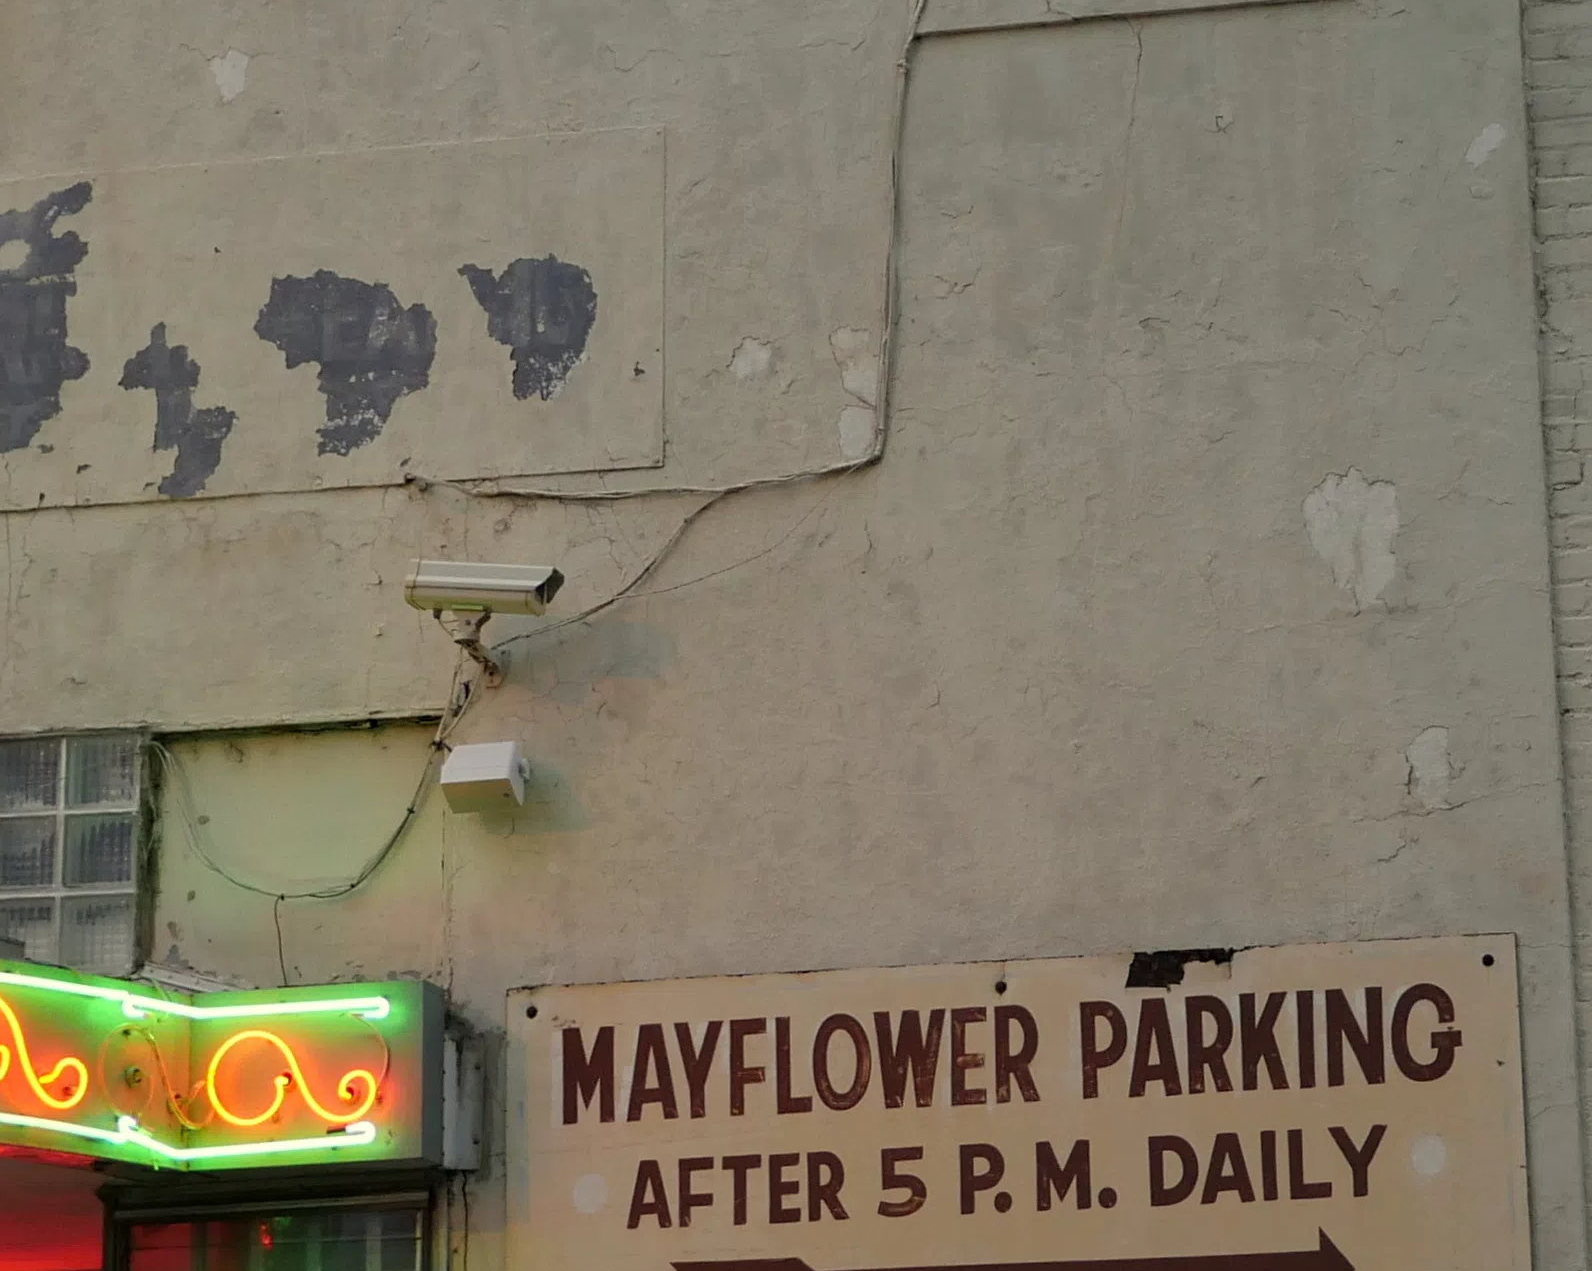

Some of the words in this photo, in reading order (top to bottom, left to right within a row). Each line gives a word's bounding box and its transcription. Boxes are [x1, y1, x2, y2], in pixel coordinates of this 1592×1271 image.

[562, 1005, 1041, 1126] MAYFLOWER
[1079, 982, 1463, 1100] PARKING
[626, 1150, 850, 1230] AFTER
[877, 1145, 927, 1218] 5
[1147, 1124, 1388, 1207] DAILY
